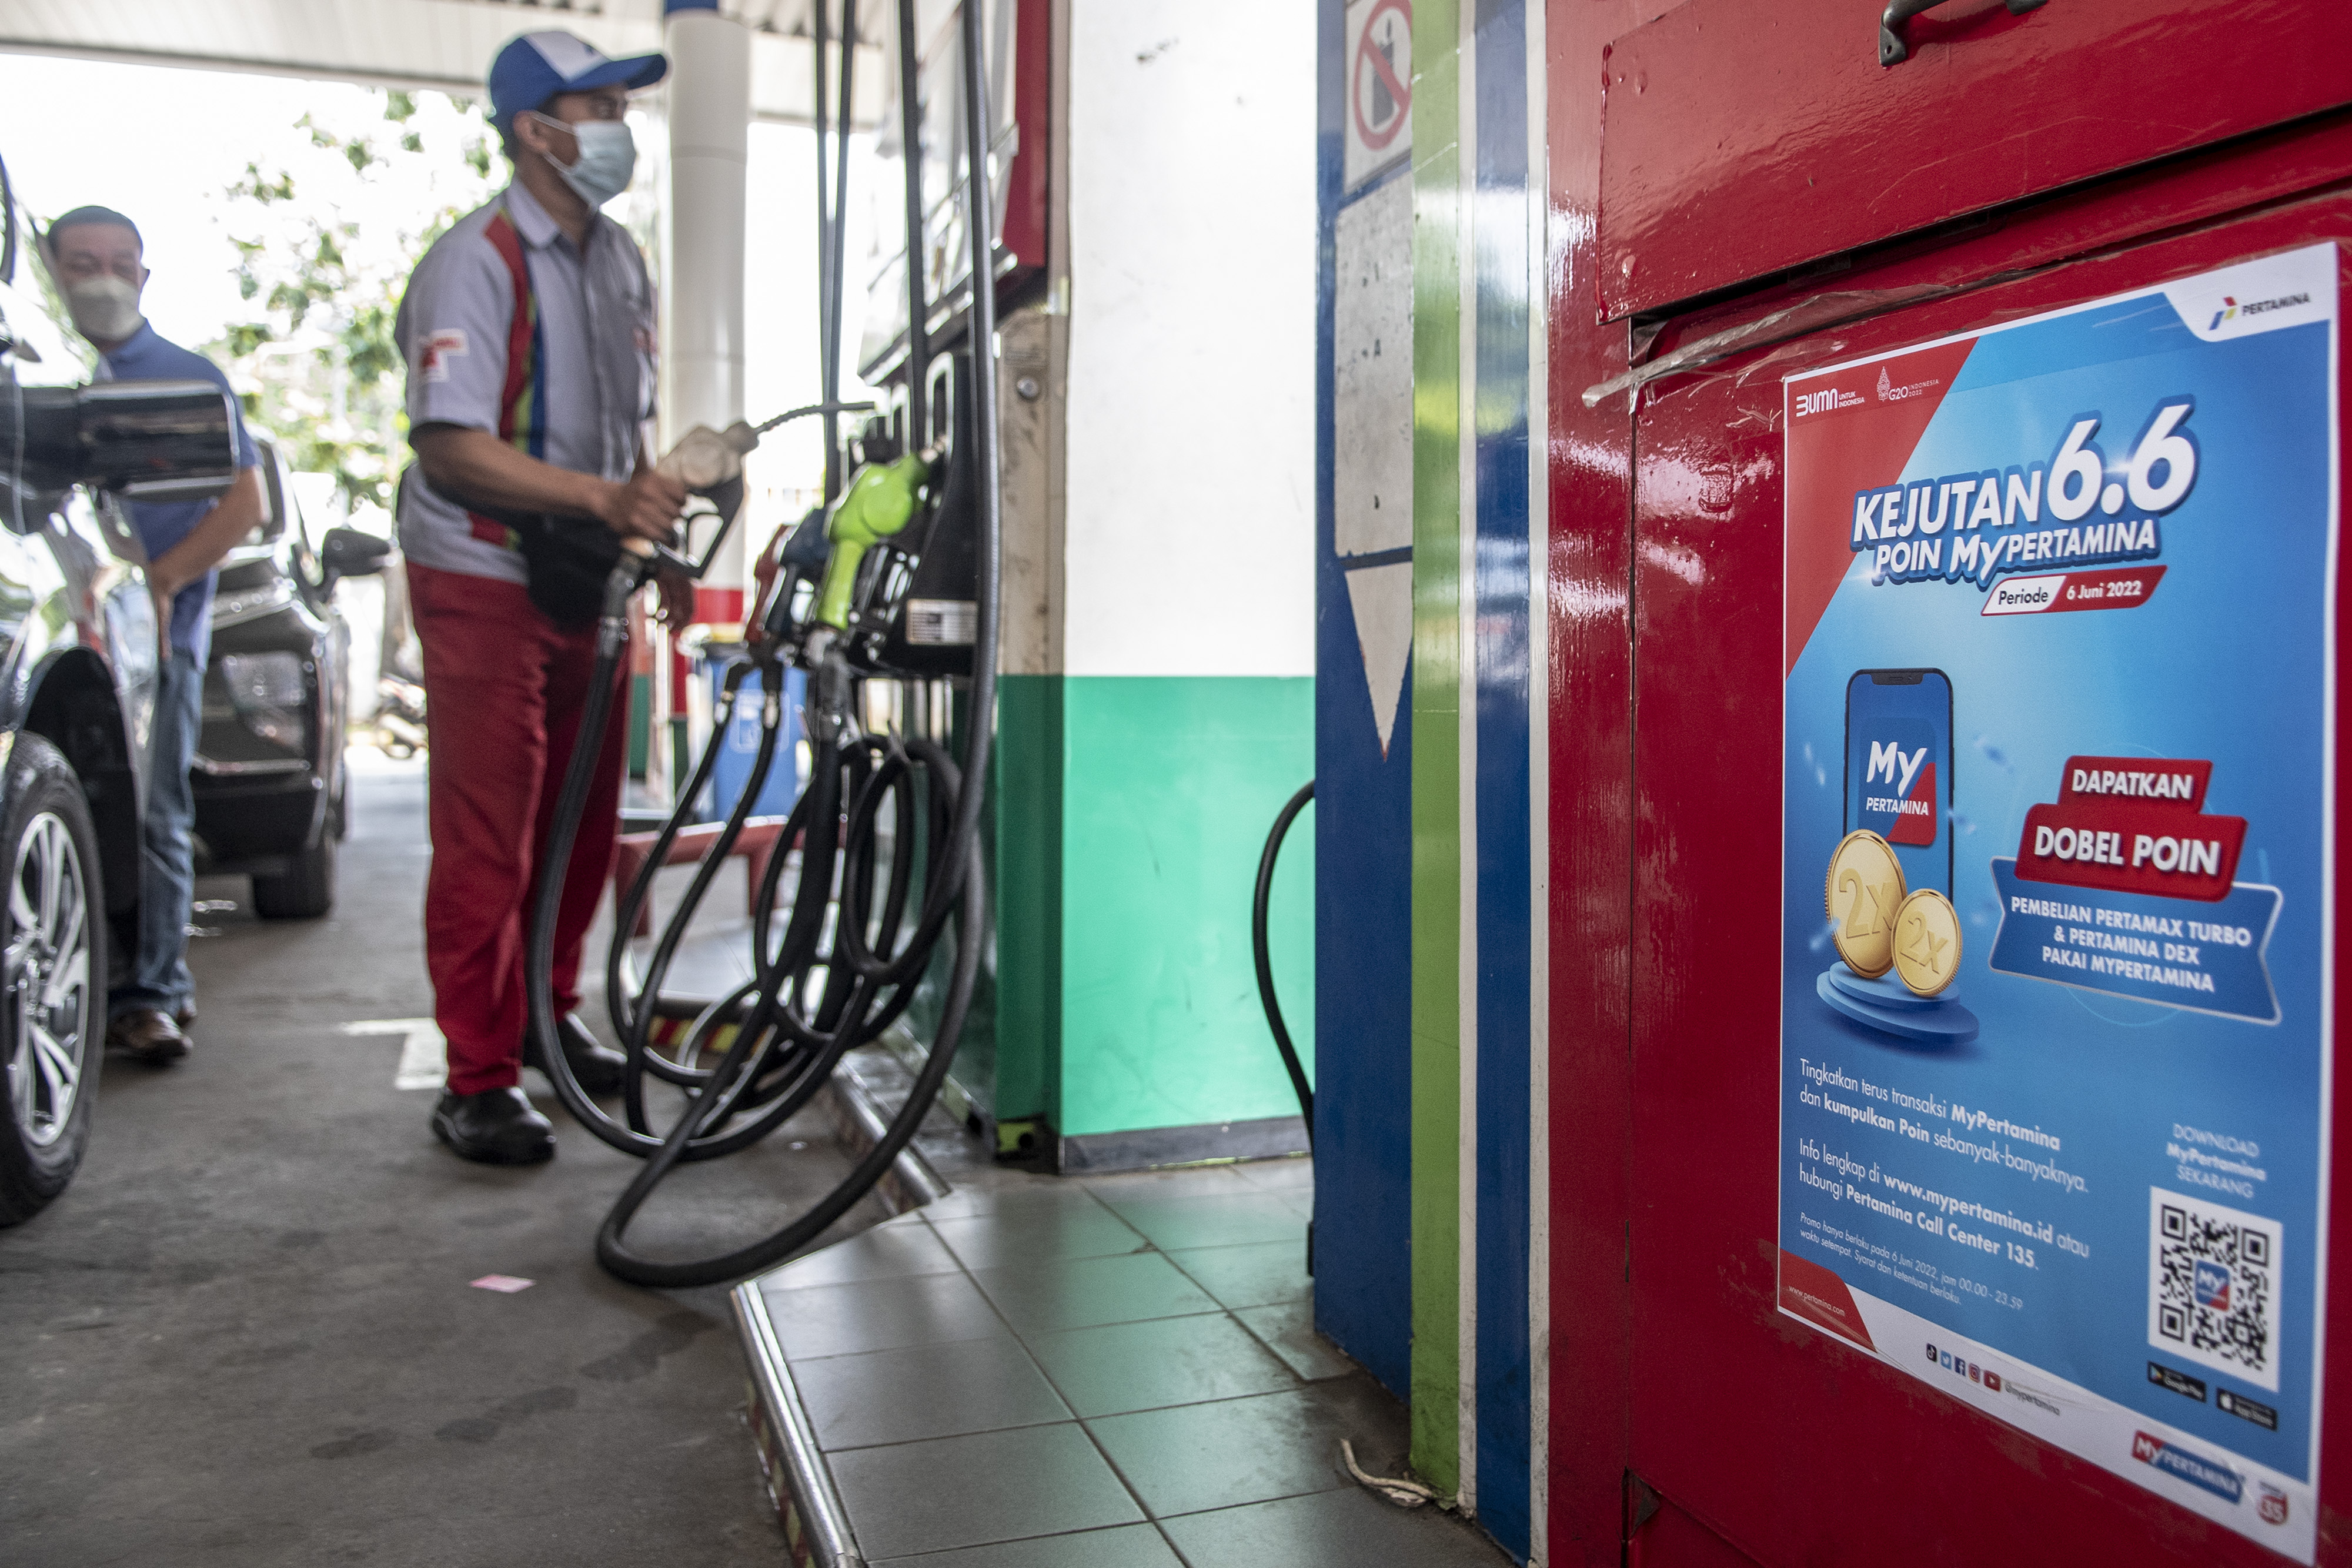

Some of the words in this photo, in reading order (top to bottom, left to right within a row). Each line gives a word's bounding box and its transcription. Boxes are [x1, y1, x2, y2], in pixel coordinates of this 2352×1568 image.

[2242, 292, 2311, 316] PERTAMINA
[1839, 391, 1856, 400] UNTUK
[1839, 397, 1865, 408] INDONESIA
[1889, 386, 1909, 401] G20
[1909, 379, 1939, 390] INDONESIA
[1909, 389, 1922, 397] 2022
[1854, 470, 2042, 542] KEJUTAN
[2047, 404, 2195, 520] 6.6
[1875, 539, 1942, 575] POIN
[1999, 587, 2049, 606] Periode
[2066, 585, 2075, 600] 6
[2077, 581, 2104, 600] Juni
[2106, 580, 2142, 597] 2022
[1866, 741, 1927, 798] My
[2072, 769, 2194, 800] DAPATKAN
[1866, 797, 1929, 816] PERTAMINA
[2034, 825, 2125, 866] DOBEL
[2132, 834, 2221, 876] POIN
[2011, 896, 2092, 925] PEMBELIAN
[2096, 908, 2183, 938] PERTAMAX
[2187, 921, 2252, 947] TURBO
[2054, 925, 2065, 943] &
[2069, 928, 2159, 959] PERTAMINA
[2164, 942, 2200, 965] DEX
[2042, 945, 2087, 969] PAKAI
[2091, 954, 2215, 994] MYPERTAMINA
[1800, 1058, 1859, 1092] Tingkatkan
[1861, 1079, 1889, 1101] terus
[1892, 1088, 1947, 1118] transaksi
[1951, 1104, 2061, 1151] MyPertamina
[1800, 1084, 1820, 1107] dan
[1824, 1092, 1895, 1132] kumpulkan
[1899, 1118, 1930, 1143] Poin
[1933, 1128, 2089, 1193] sebanyak-banyaknya.
[2173, 1123, 2260, 1158] DOWNLOAD
[1800, 1138, 1820, 1161] Info
[1823, 1144, 1866, 1182] lengkap
[1869, 1162, 1880, 1183] di
[1883, 1174, 2053, 1244] www.mypertamina.id
[2057, 1233, 2089, 1258] atau
[2177, 1164, 2254, 1199] SEKARANG
[1799, 1162, 1843, 1201] hubungi
[1846, 1183, 1913, 1225] Pertamina
[1916, 1211, 1943, 1236] Call
[1947, 1223, 2001, 1255] Center
[2006, 1241, 2039, 1271] 135.
[1800, 1212, 1821, 1229] Promo
[1823, 1220, 1843, 1240] hanya
[1845, 1229, 1869, 1250] berlaku
[1871, 1243, 1890, 1259] pada
[1892, 1251, 1897, 1262] 6
[1898, 1254, 1913, 1268] Juni
[1915, 1260, 1939, 1281] 2022,
[1941, 1271, 1957, 1286] jam
[1959, 1278, 1988, 1297] 00.00
[1994, 1290, 2023, 1310] 23.59
[1800, 1229, 1820, 1244] waktu
[1820, 1238, 1852, 1258] setempat.
[1854, 1249, 1876, 1268] Syarat
[1877, 1261, 1892, 1276] dan
[1893, 1266, 1927, 1291] ketentuan
[1930, 1281, 1962, 1305] berlaku.
[1788, 1285, 1846, 1317] www.pertamina.com
